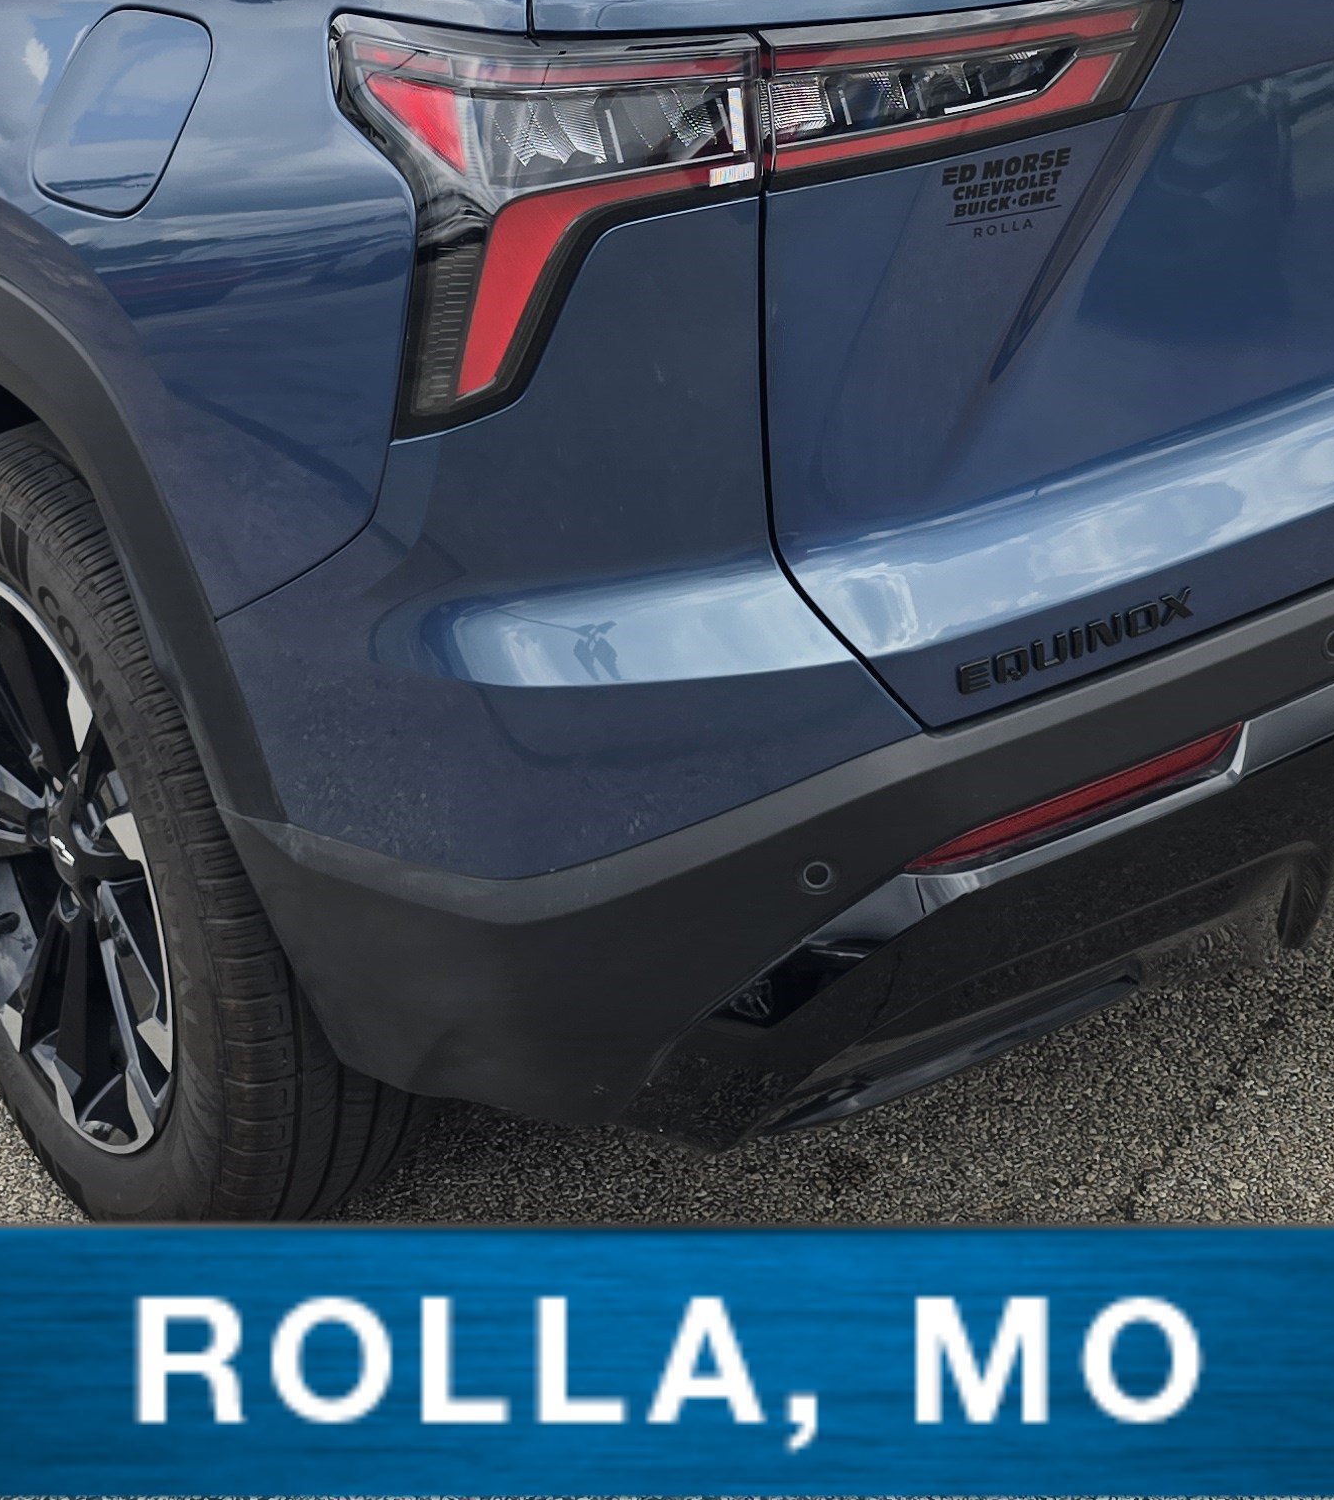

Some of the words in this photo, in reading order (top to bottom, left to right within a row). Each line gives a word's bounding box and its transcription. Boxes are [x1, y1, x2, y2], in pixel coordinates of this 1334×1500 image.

[942, 165, 977, 186] ED
[982, 147, 1071, 181] MORSE
[953, 170, 1062, 201] CHEVROLET
[974, 219, 1033, 238] ROLLA
[956, 586, 1194, 695] EQUINOX
